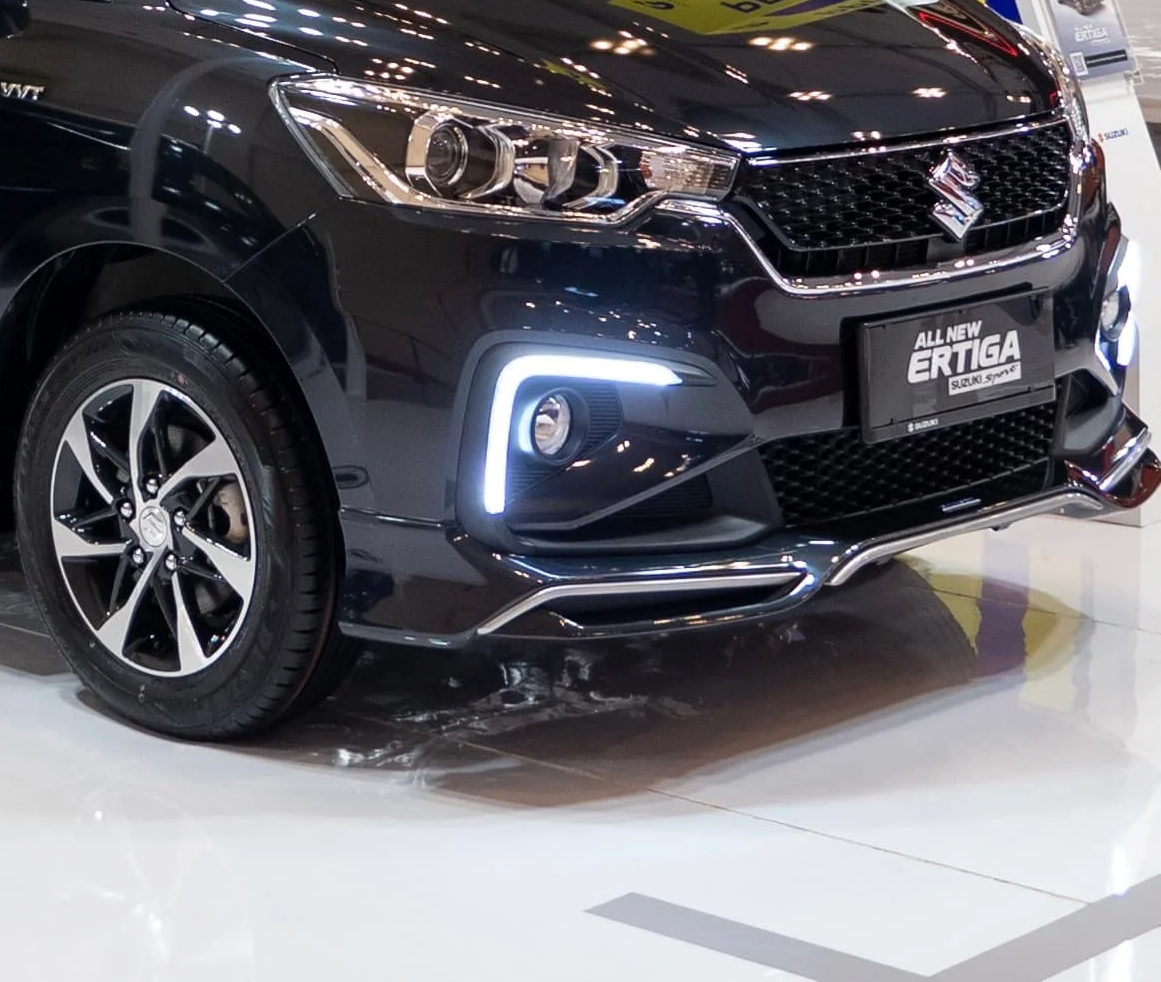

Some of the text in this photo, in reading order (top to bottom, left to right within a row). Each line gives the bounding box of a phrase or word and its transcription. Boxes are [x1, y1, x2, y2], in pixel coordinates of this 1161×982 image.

[914, 320, 982, 350] ALL NEW
[908, 330, 1021, 384] ERTIGA
[950, 375, 983, 391] SUZUKI
[915, 419, 939, 431] SUZUKI
